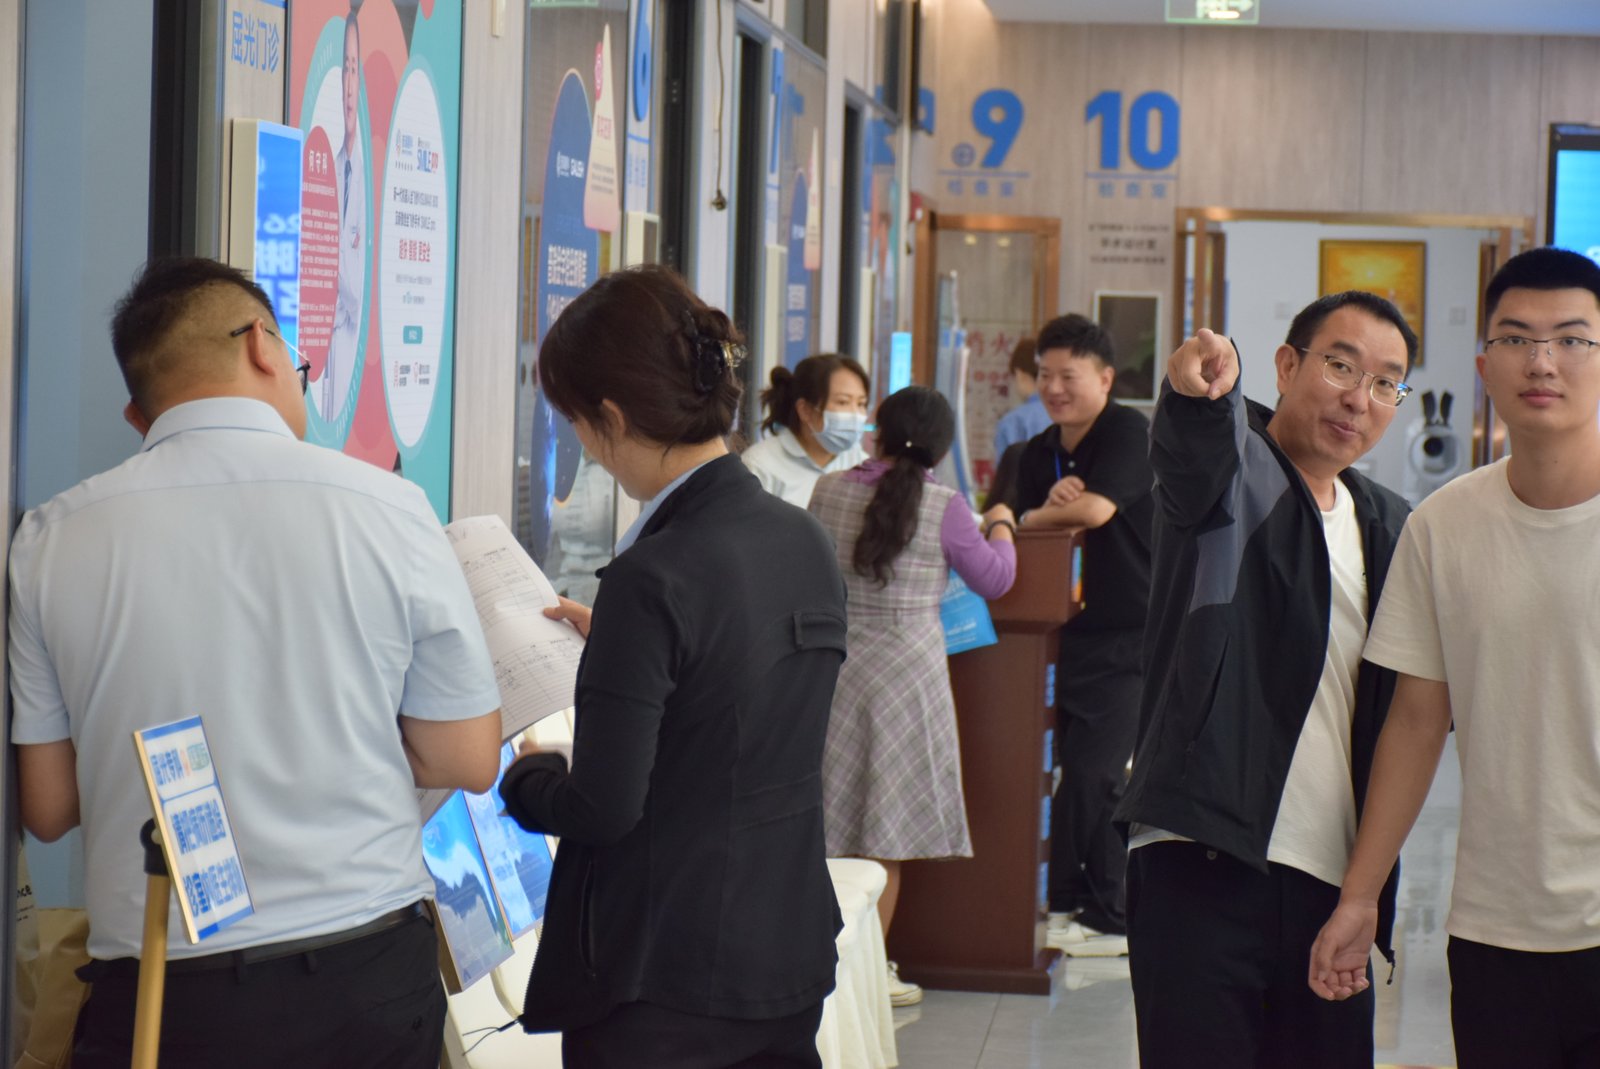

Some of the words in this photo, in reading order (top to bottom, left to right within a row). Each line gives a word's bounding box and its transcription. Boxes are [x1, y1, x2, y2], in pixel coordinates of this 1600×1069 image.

[231, 10, 280, 73] 屈光门诊
[971, 88, 1024, 169] 9
[1085, 90, 1181, 170] 10
